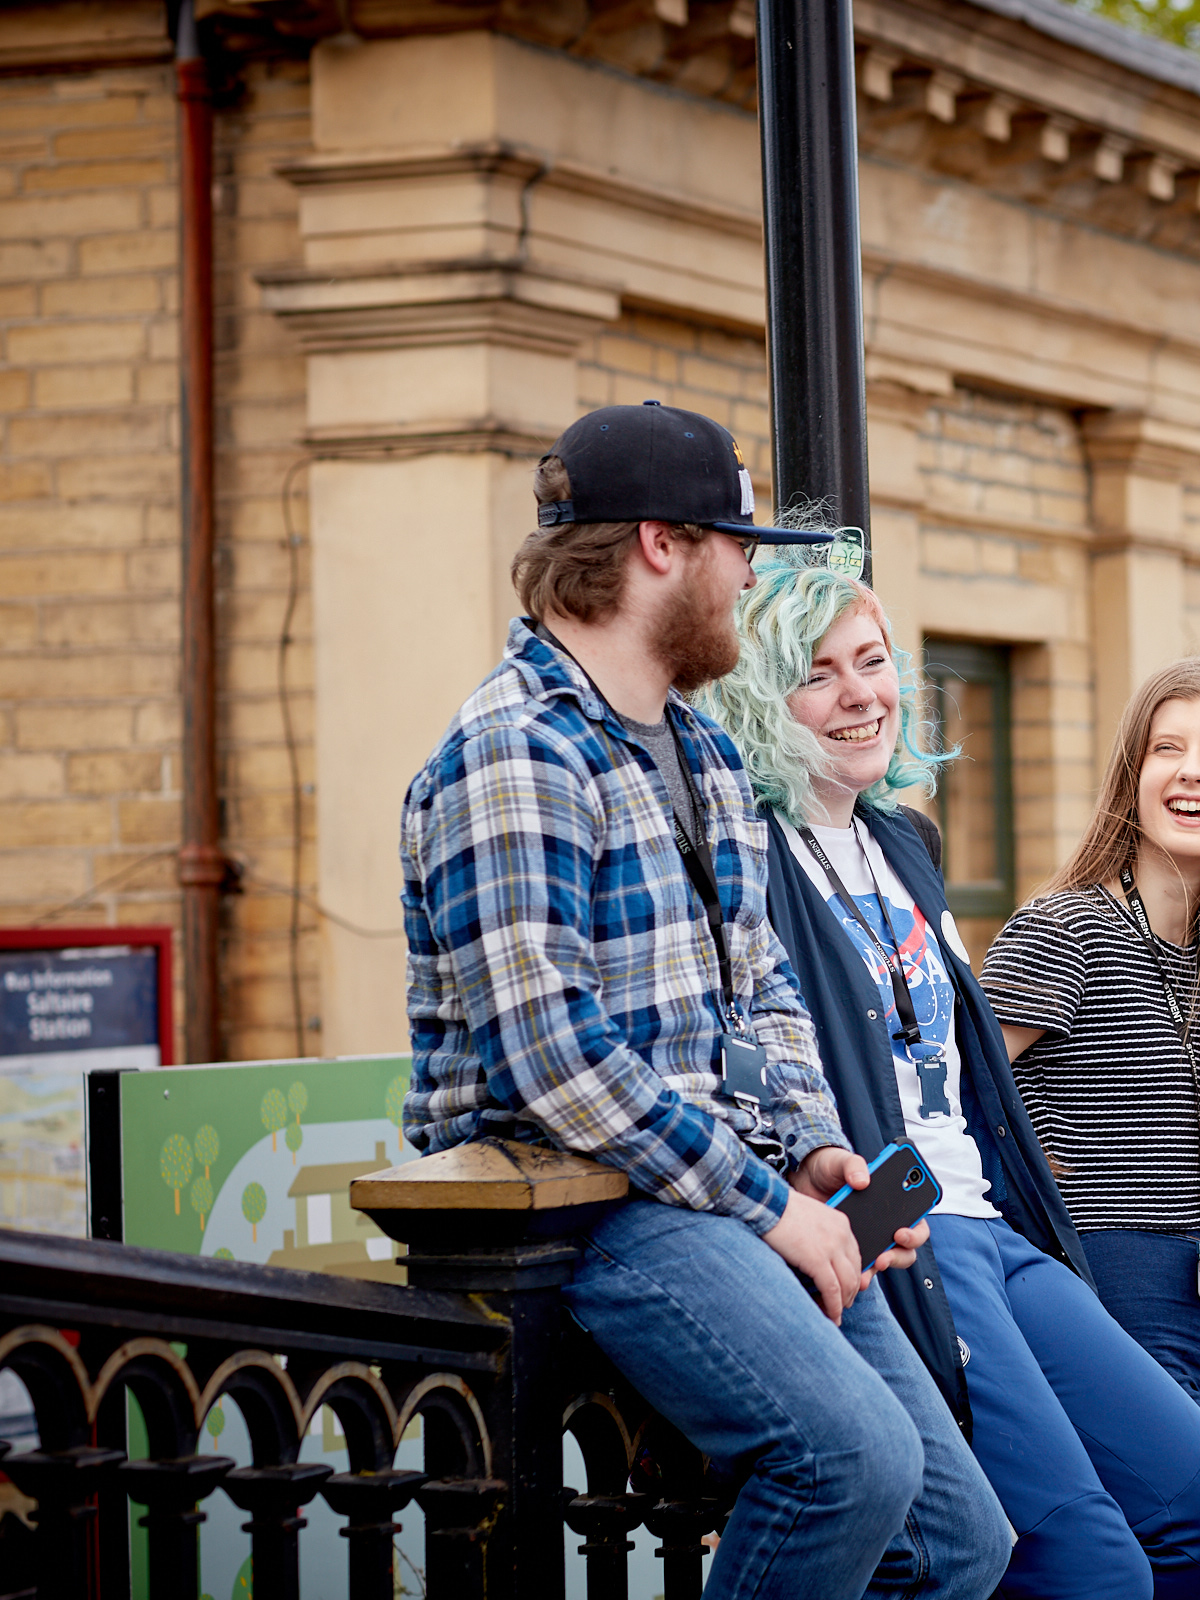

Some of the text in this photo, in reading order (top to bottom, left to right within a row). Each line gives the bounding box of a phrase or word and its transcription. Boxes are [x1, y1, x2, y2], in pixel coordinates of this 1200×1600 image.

[807, 839, 831, 870] STUDENT
[1131, 899, 1152, 940] STUDENT
[874, 941, 895, 973] STUDENT
[27, 991, 93, 1014] Saltaire
[1164, 983, 1183, 1023] STUDENT
[29, 1018, 91, 1040] Station
